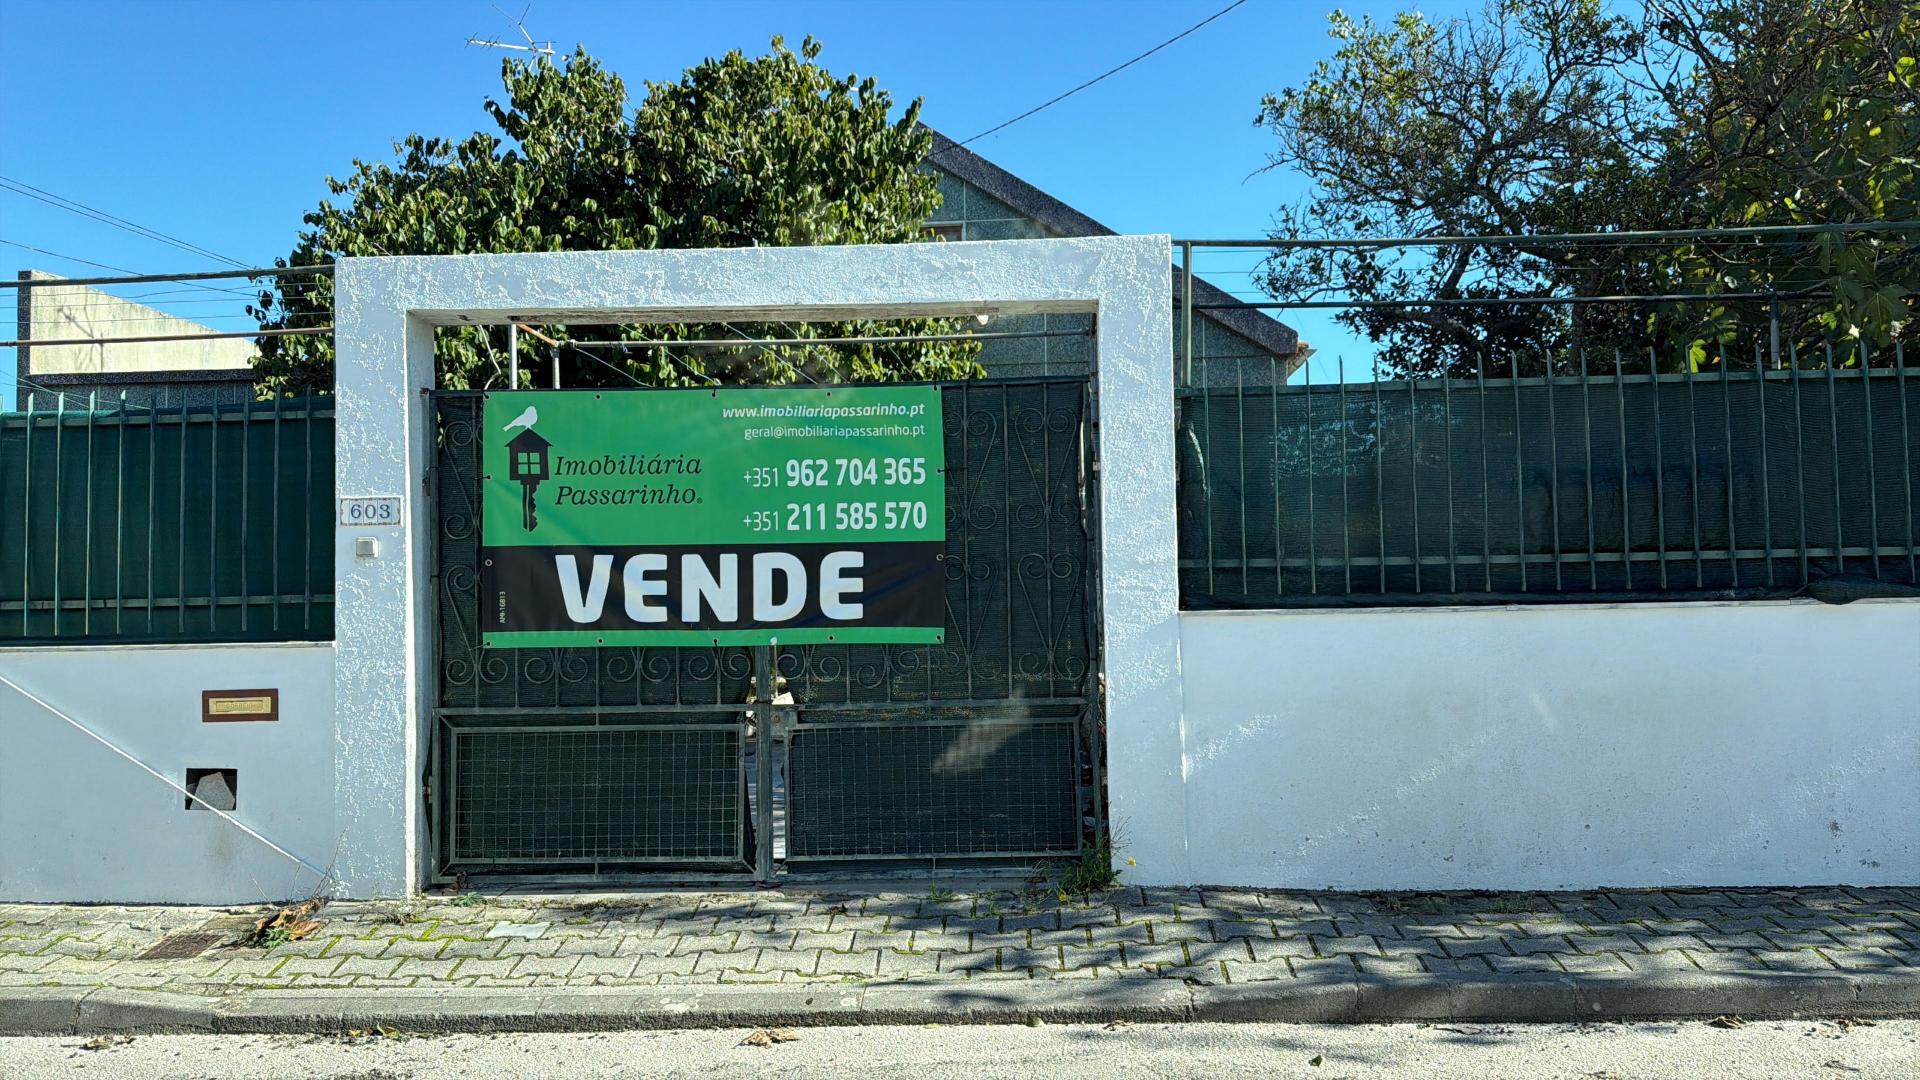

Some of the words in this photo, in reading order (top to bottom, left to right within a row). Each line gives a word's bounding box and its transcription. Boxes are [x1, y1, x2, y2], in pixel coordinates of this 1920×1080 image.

[722, 403, 925, 419] www.imobiliariapassarinho.pt
[744, 424, 925, 440] geral@imobiliariapassarinho.pt
[554, 454, 702, 475] Imobiliária
[743, 467, 778, 487] +351
[786, 459, 828, 487] 962
[835, 458, 877, 486] 704
[884, 457, 926, 485] 365
[350, 503, 390, 519] 603
[743, 511, 779, 531] +351
[787, 503, 826, 530] 211
[835, 502, 878, 530] 585
[884, 501, 927, 529] 570
[555, 551, 864, 623] VENDE
